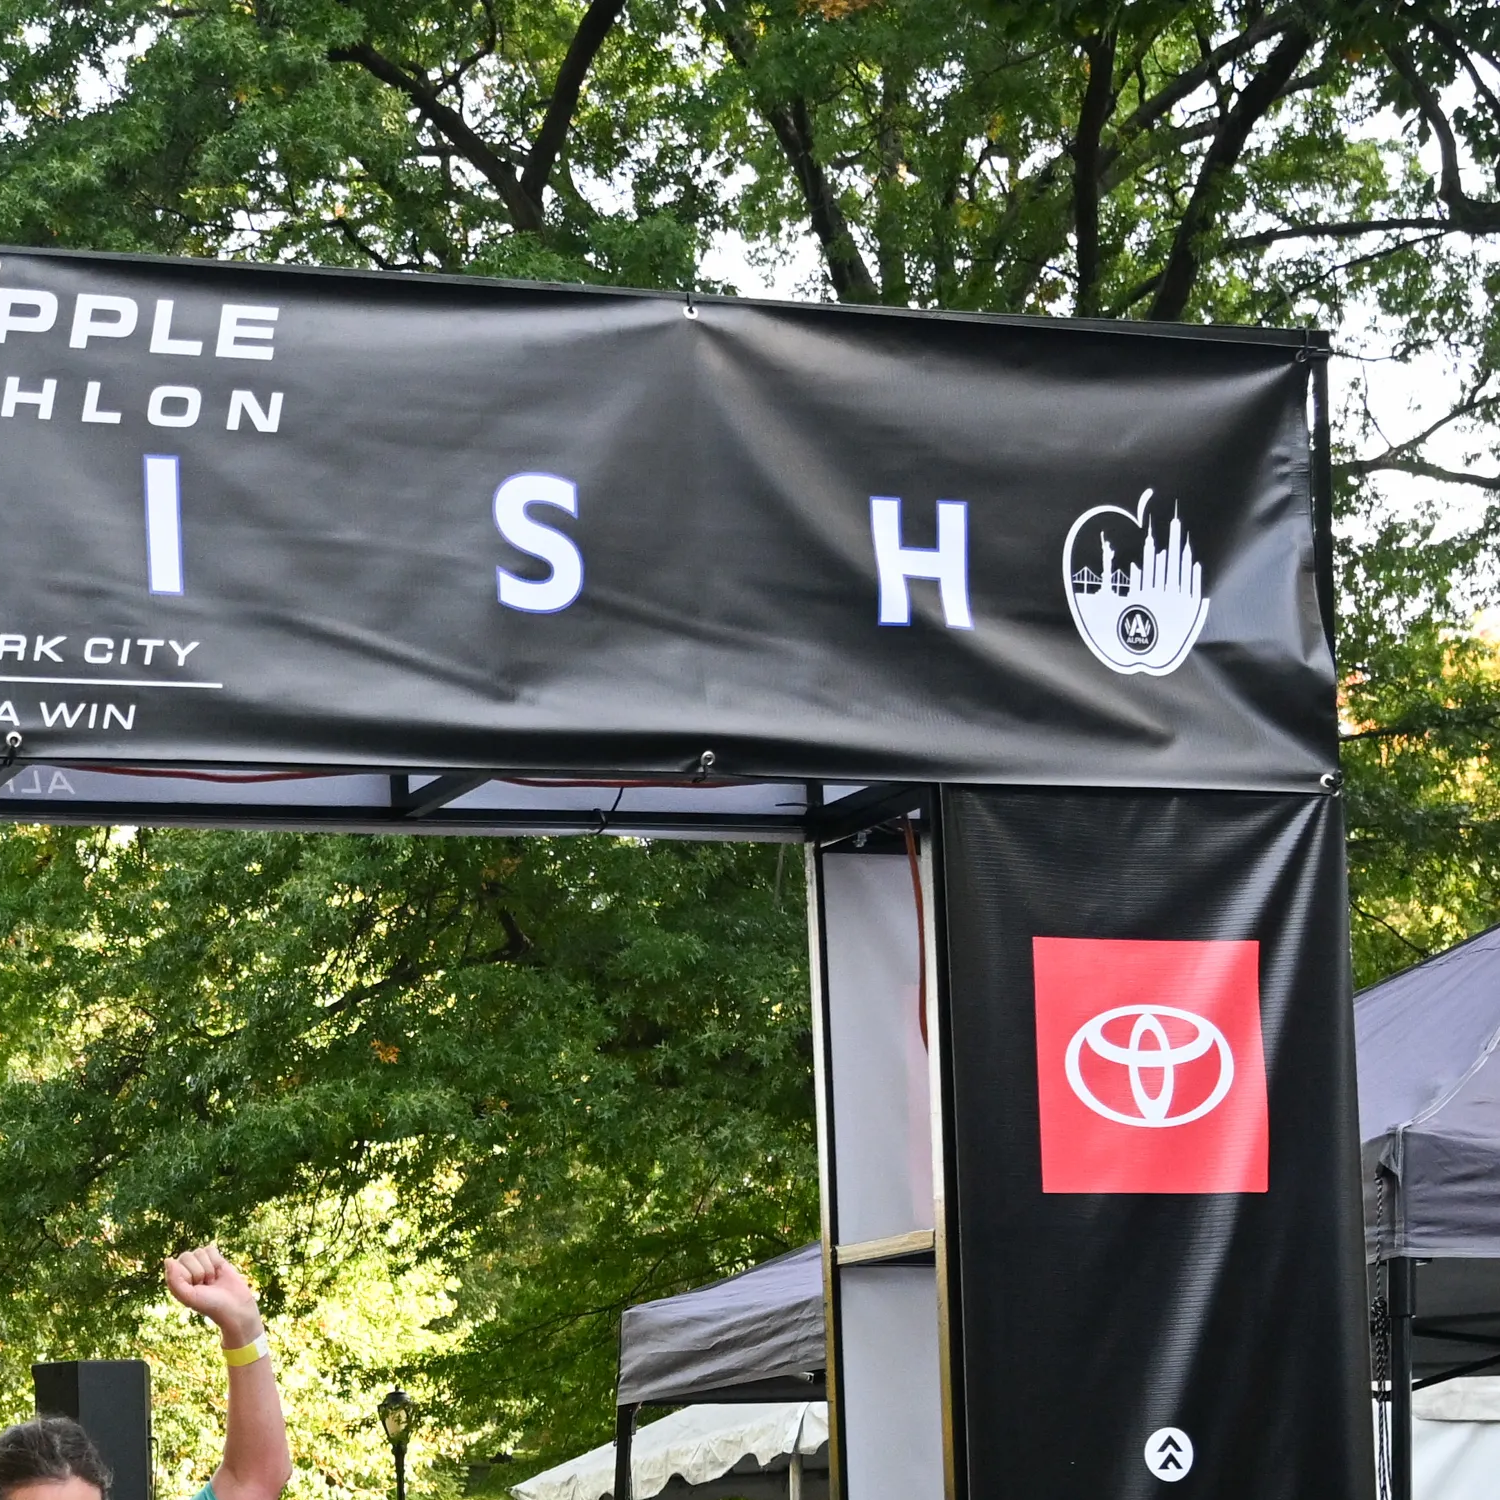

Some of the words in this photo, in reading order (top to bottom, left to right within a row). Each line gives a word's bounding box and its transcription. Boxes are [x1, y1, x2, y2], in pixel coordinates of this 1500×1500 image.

[82, 637, 202, 668] CITY
[1126, 636, 1150, 645] ALPHA
[38, 701, 138, 732] WIN
